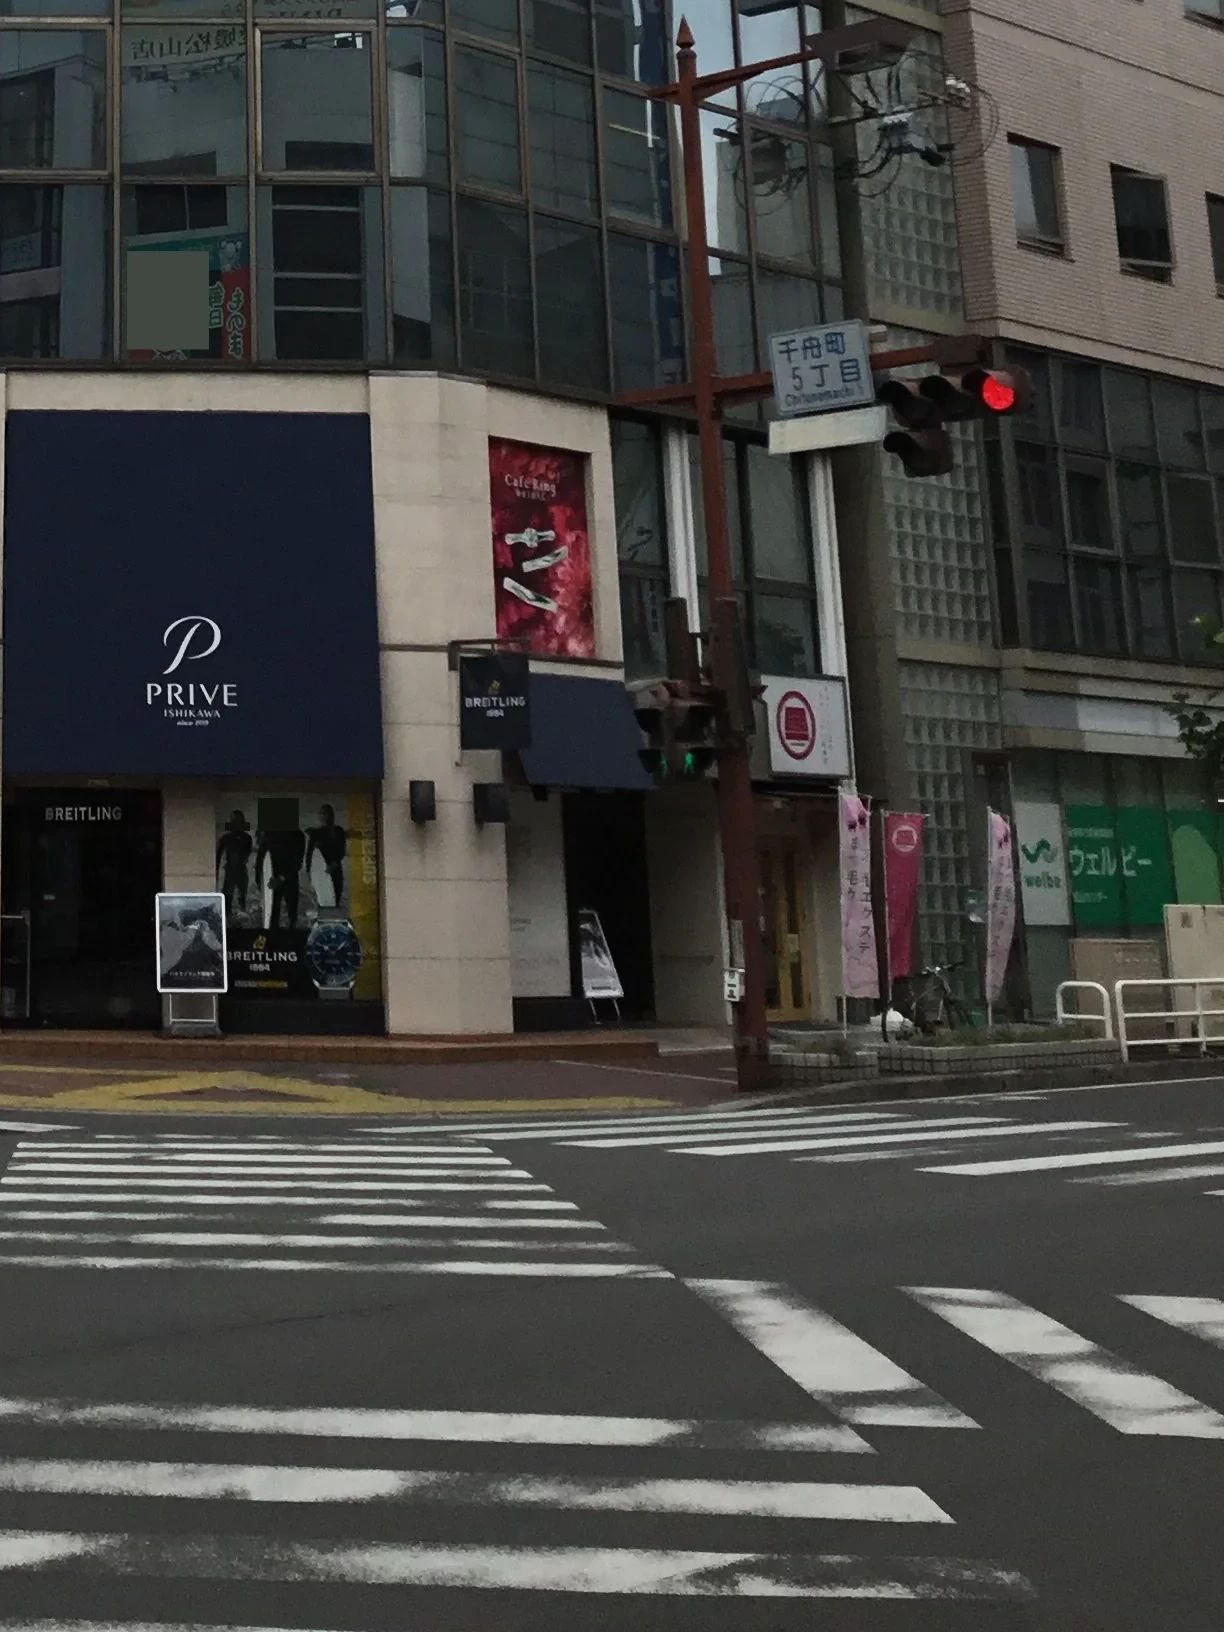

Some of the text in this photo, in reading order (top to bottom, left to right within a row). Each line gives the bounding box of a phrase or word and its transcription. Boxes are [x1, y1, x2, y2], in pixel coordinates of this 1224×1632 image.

[778, 332, 846, 363] 千舟町
[792, 358, 861, 391] 5丁目
[146, 683, 238, 706] PRIVE
[465, 696, 526, 708] BREITLING
[164, 709, 221, 718] ISHIKAWA
[45, 807, 122, 821] BREITLING
[1069, 845, 1152, 877] ウェルビー
[226, 951, 298, 962] BREITLING
